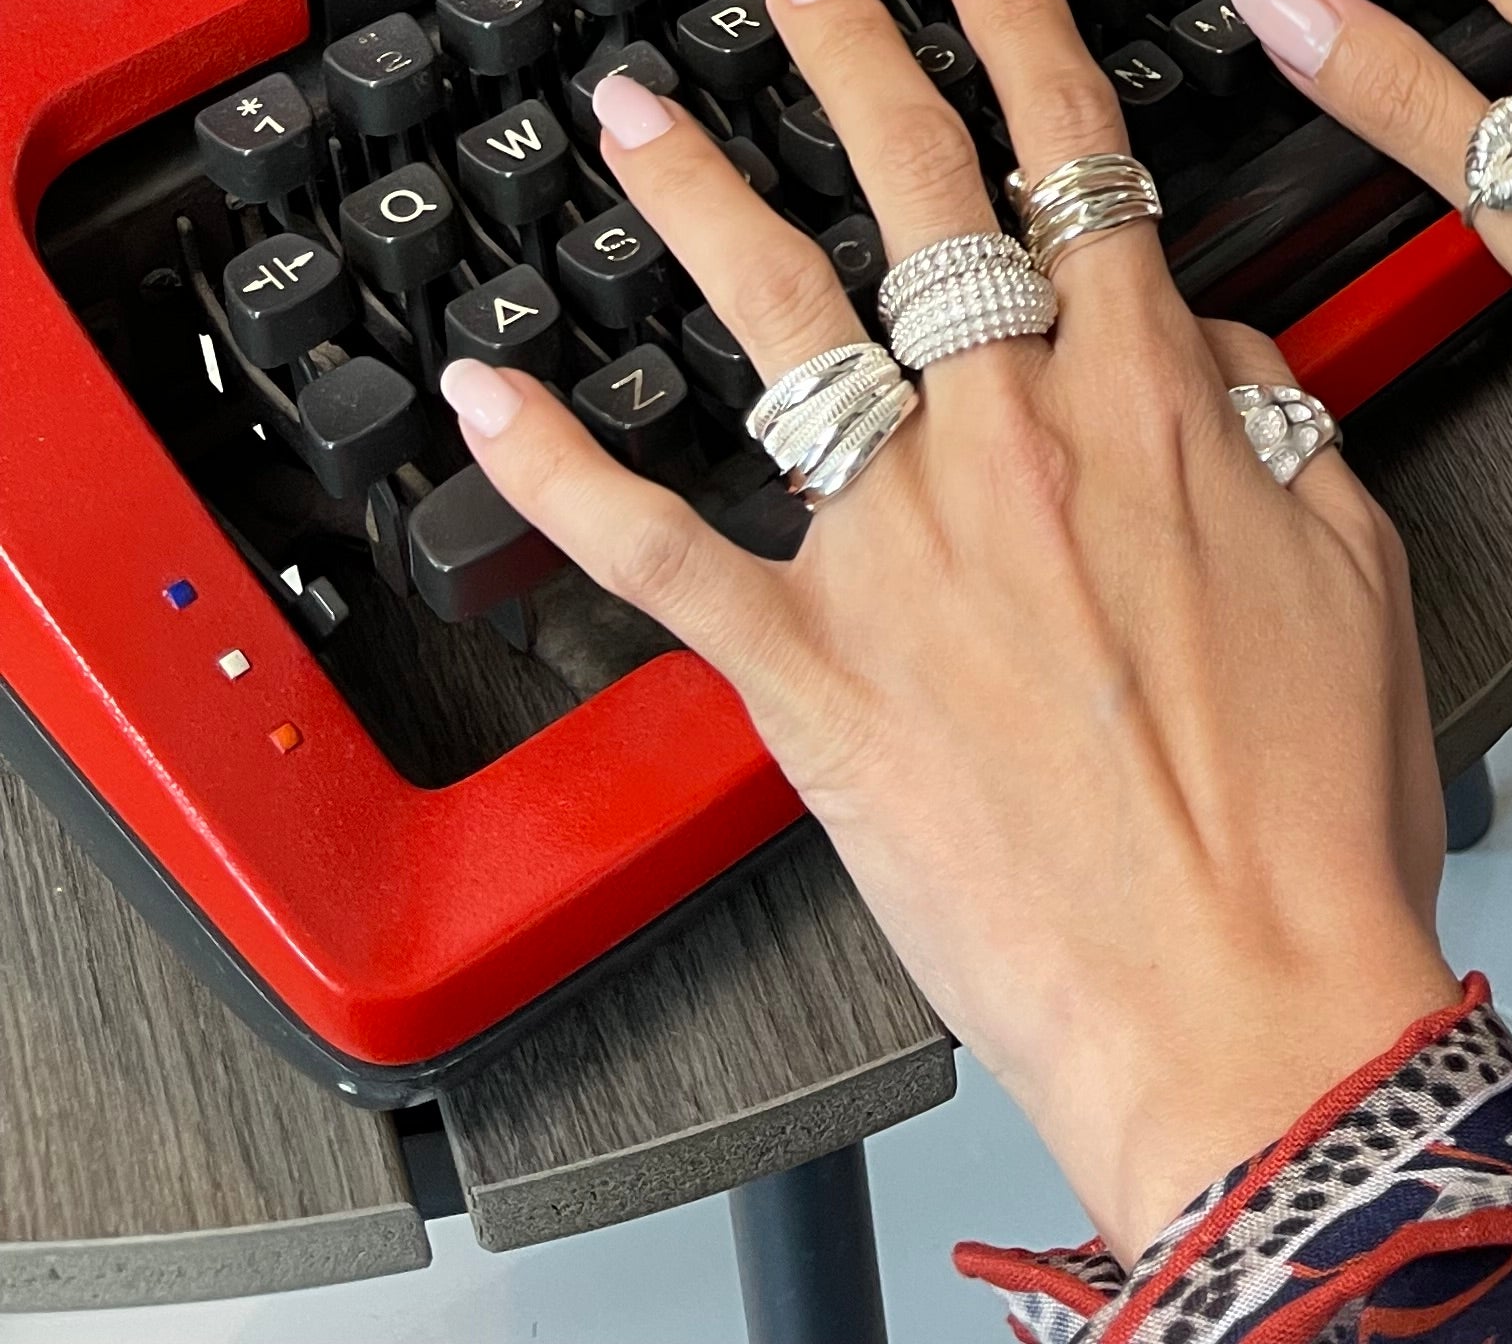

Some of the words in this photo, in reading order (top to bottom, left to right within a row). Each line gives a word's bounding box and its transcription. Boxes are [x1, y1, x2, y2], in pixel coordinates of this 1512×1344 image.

[711, 5, 760, 38] R
[487, 119, 542, 160] W
[380, 188, 437, 223] Q
[594, 227, 640, 262] S
[493, 297, 539, 333] A
[611, 369, 665, 410] Z
